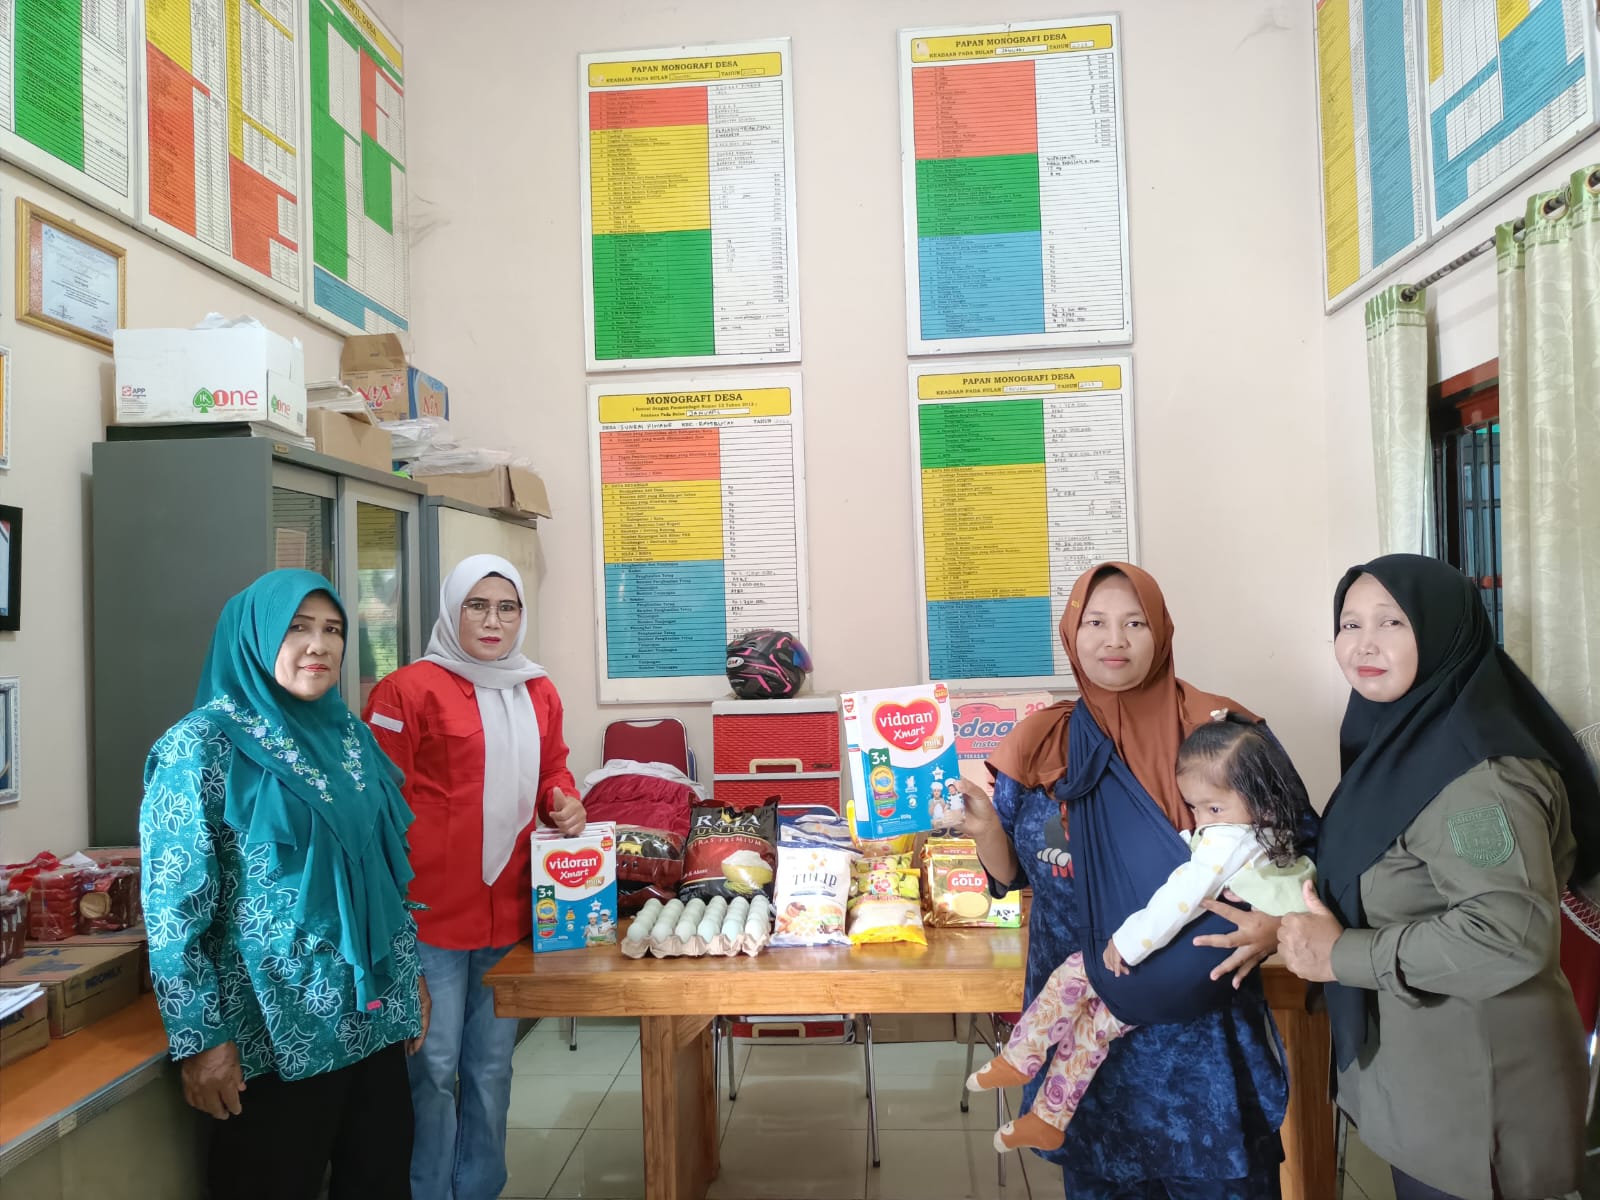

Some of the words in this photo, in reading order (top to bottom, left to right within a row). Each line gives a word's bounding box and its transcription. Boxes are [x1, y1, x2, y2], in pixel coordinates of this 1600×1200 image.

[955, 40, 984, 48] PAPAN
[986, 36, 1040, 46] MONOGRAFI
[1044, 34, 1067, 42] DESA
[661, 62, 712, 72] MONOGRAFI
[715, 60, 738, 68] DESA
[994, 374, 1048, 384] MONOGRAFI
[646, 394, 711, 404] MONOGRAFI
[714, 393, 743, 402] DESA
[880, 712, 932, 728] vidoran
[893, 726, 925, 740] Xmart
[871, 752, 888, 764] 3+
[549, 856, 598, 870] vidoran
[560, 868, 589, 880] Xmart
[952, 878, 982, 886] GOLD
[538, 888, 553, 898] 3+
